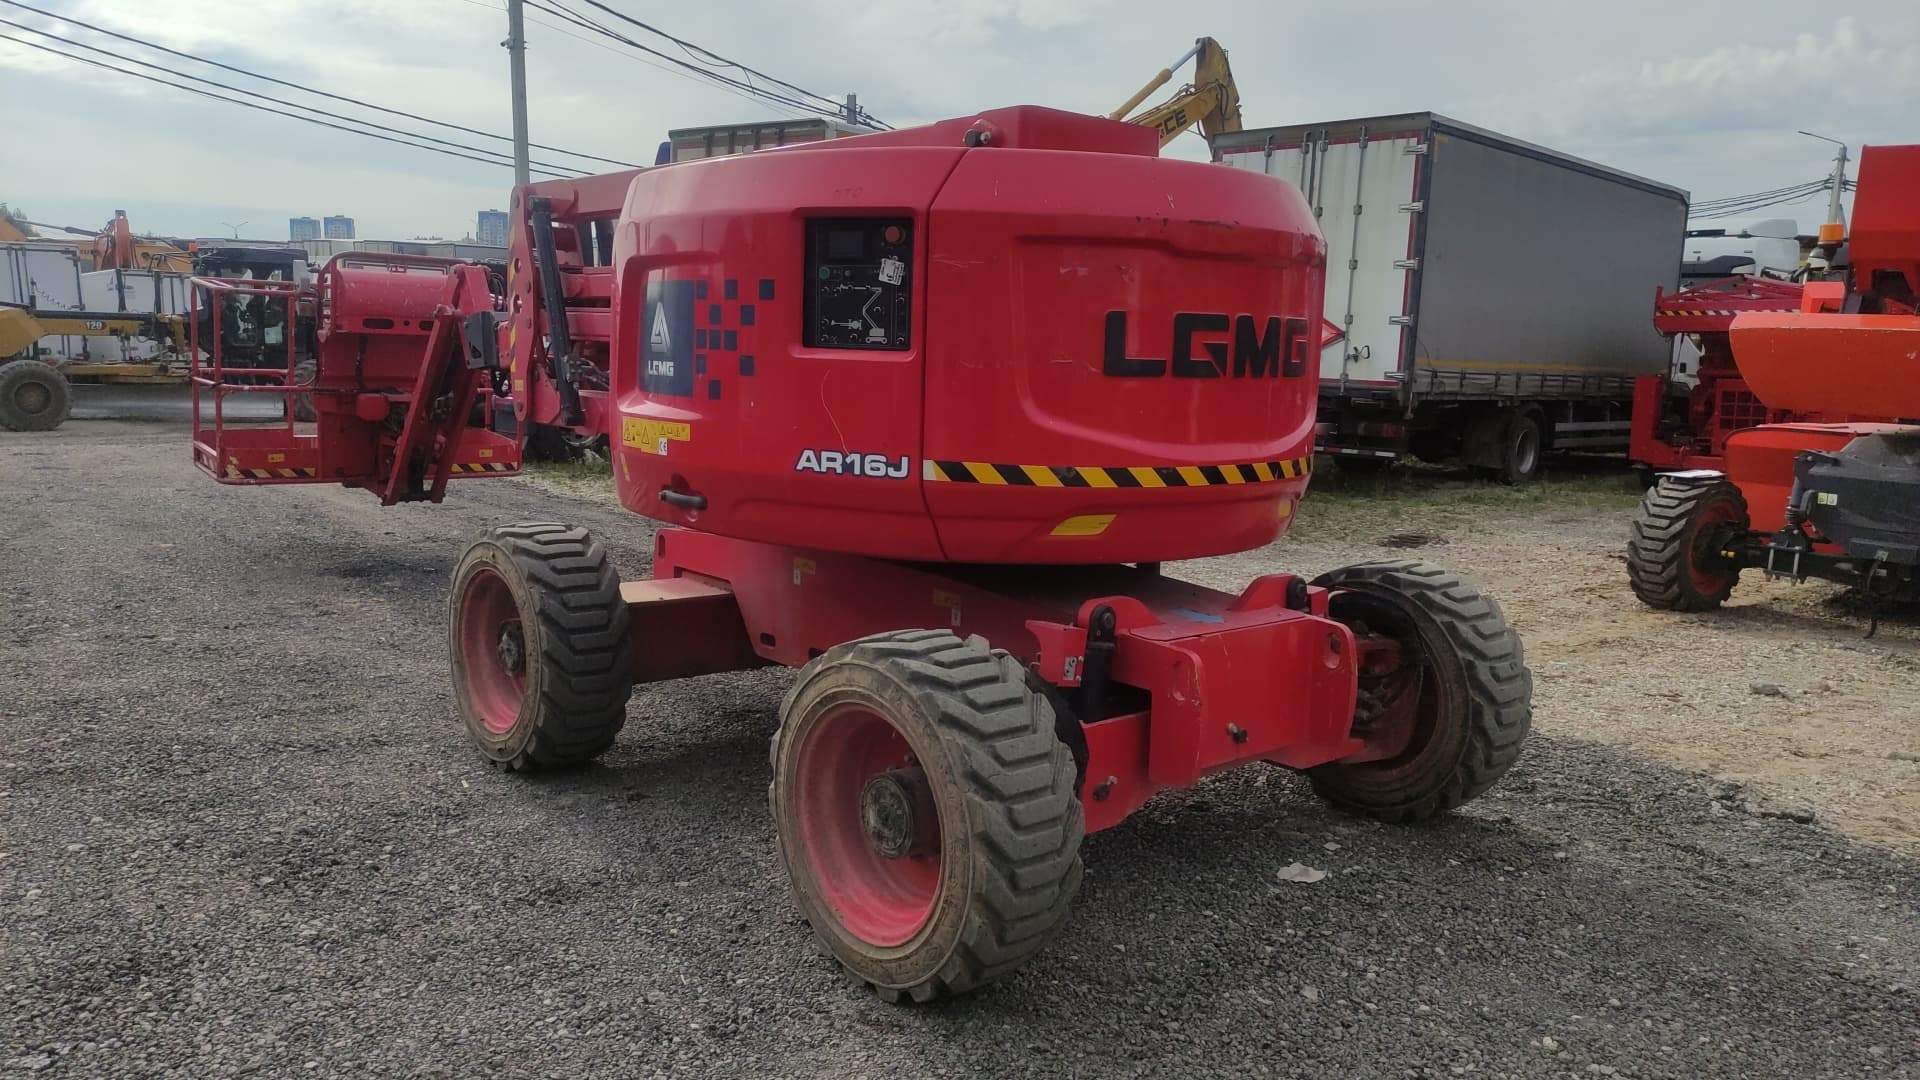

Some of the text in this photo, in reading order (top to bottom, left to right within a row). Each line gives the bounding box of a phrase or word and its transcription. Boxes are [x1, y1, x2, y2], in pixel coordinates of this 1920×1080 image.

[1103, 310, 1308, 378] LGMG
[648, 359, 674, 377] LGMG
[795, 449, 909, 478] AR16J
